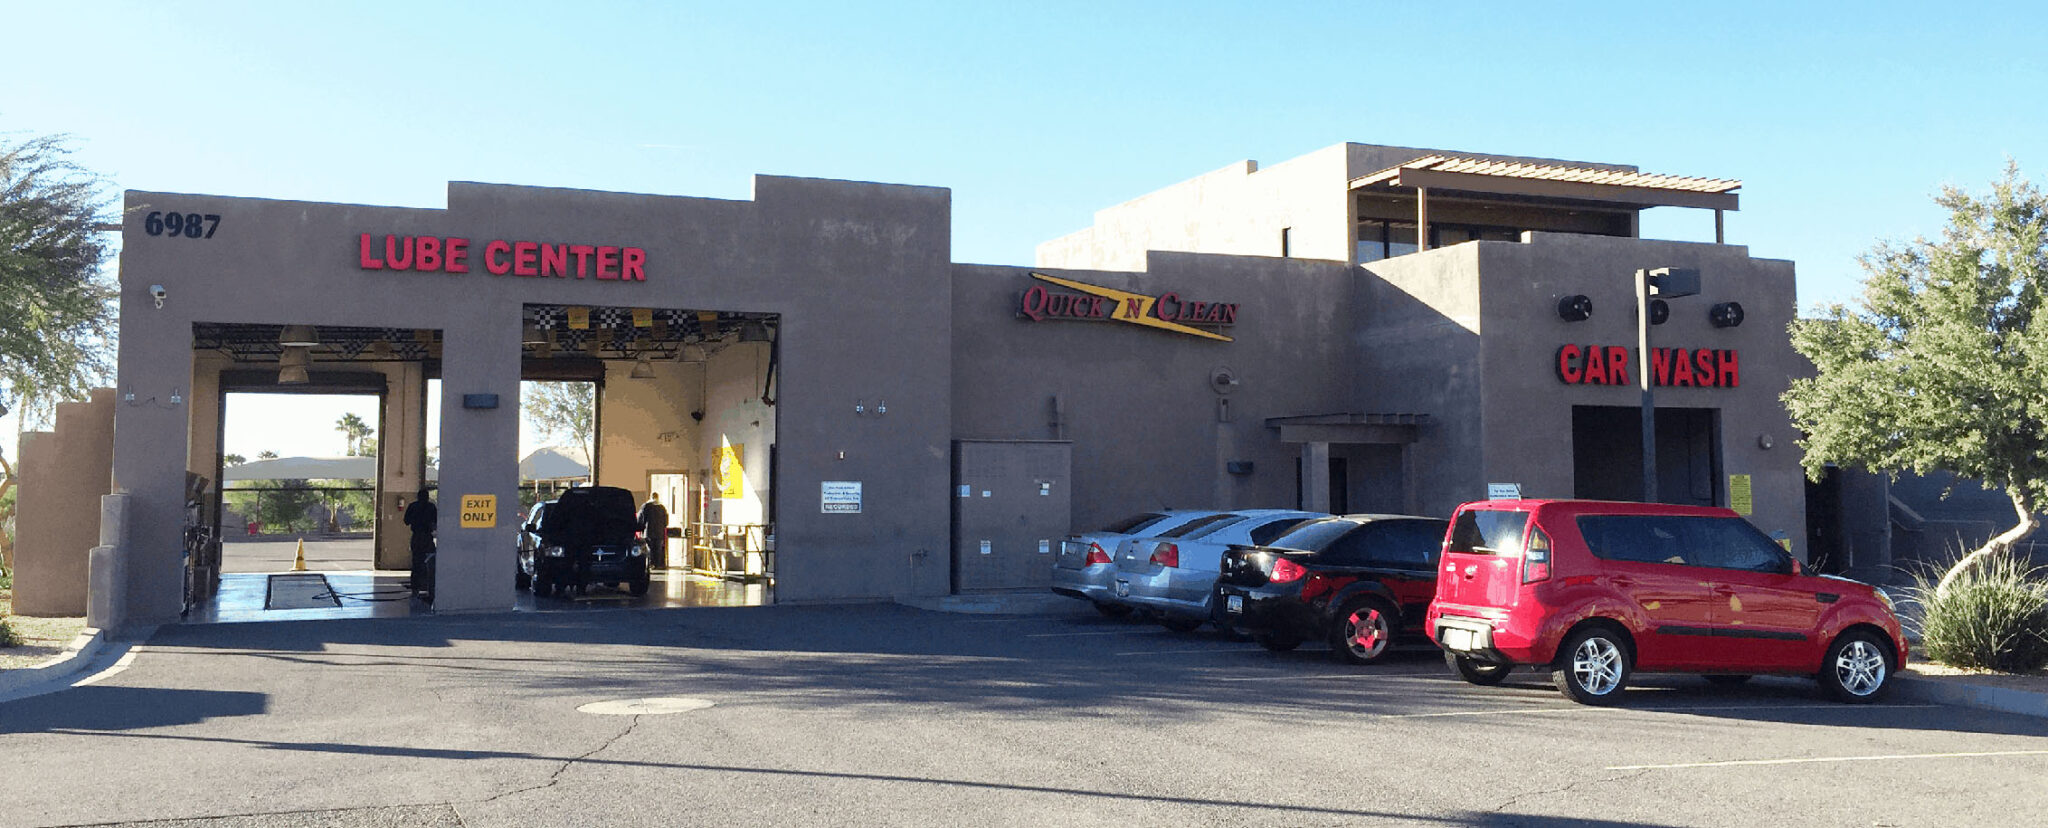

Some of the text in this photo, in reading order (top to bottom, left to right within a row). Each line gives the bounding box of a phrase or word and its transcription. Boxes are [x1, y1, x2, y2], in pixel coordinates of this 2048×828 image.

[145, 211, 221, 239] 6987
[360, 233, 647, 281] LUBE CENTER
[1022, 285, 1241, 323] QUICK N CLEAN
[1557, 343, 1631, 386] CAR
[463, 512, 494, 521] ONLY
[466, 500, 492, 508] EXIT
